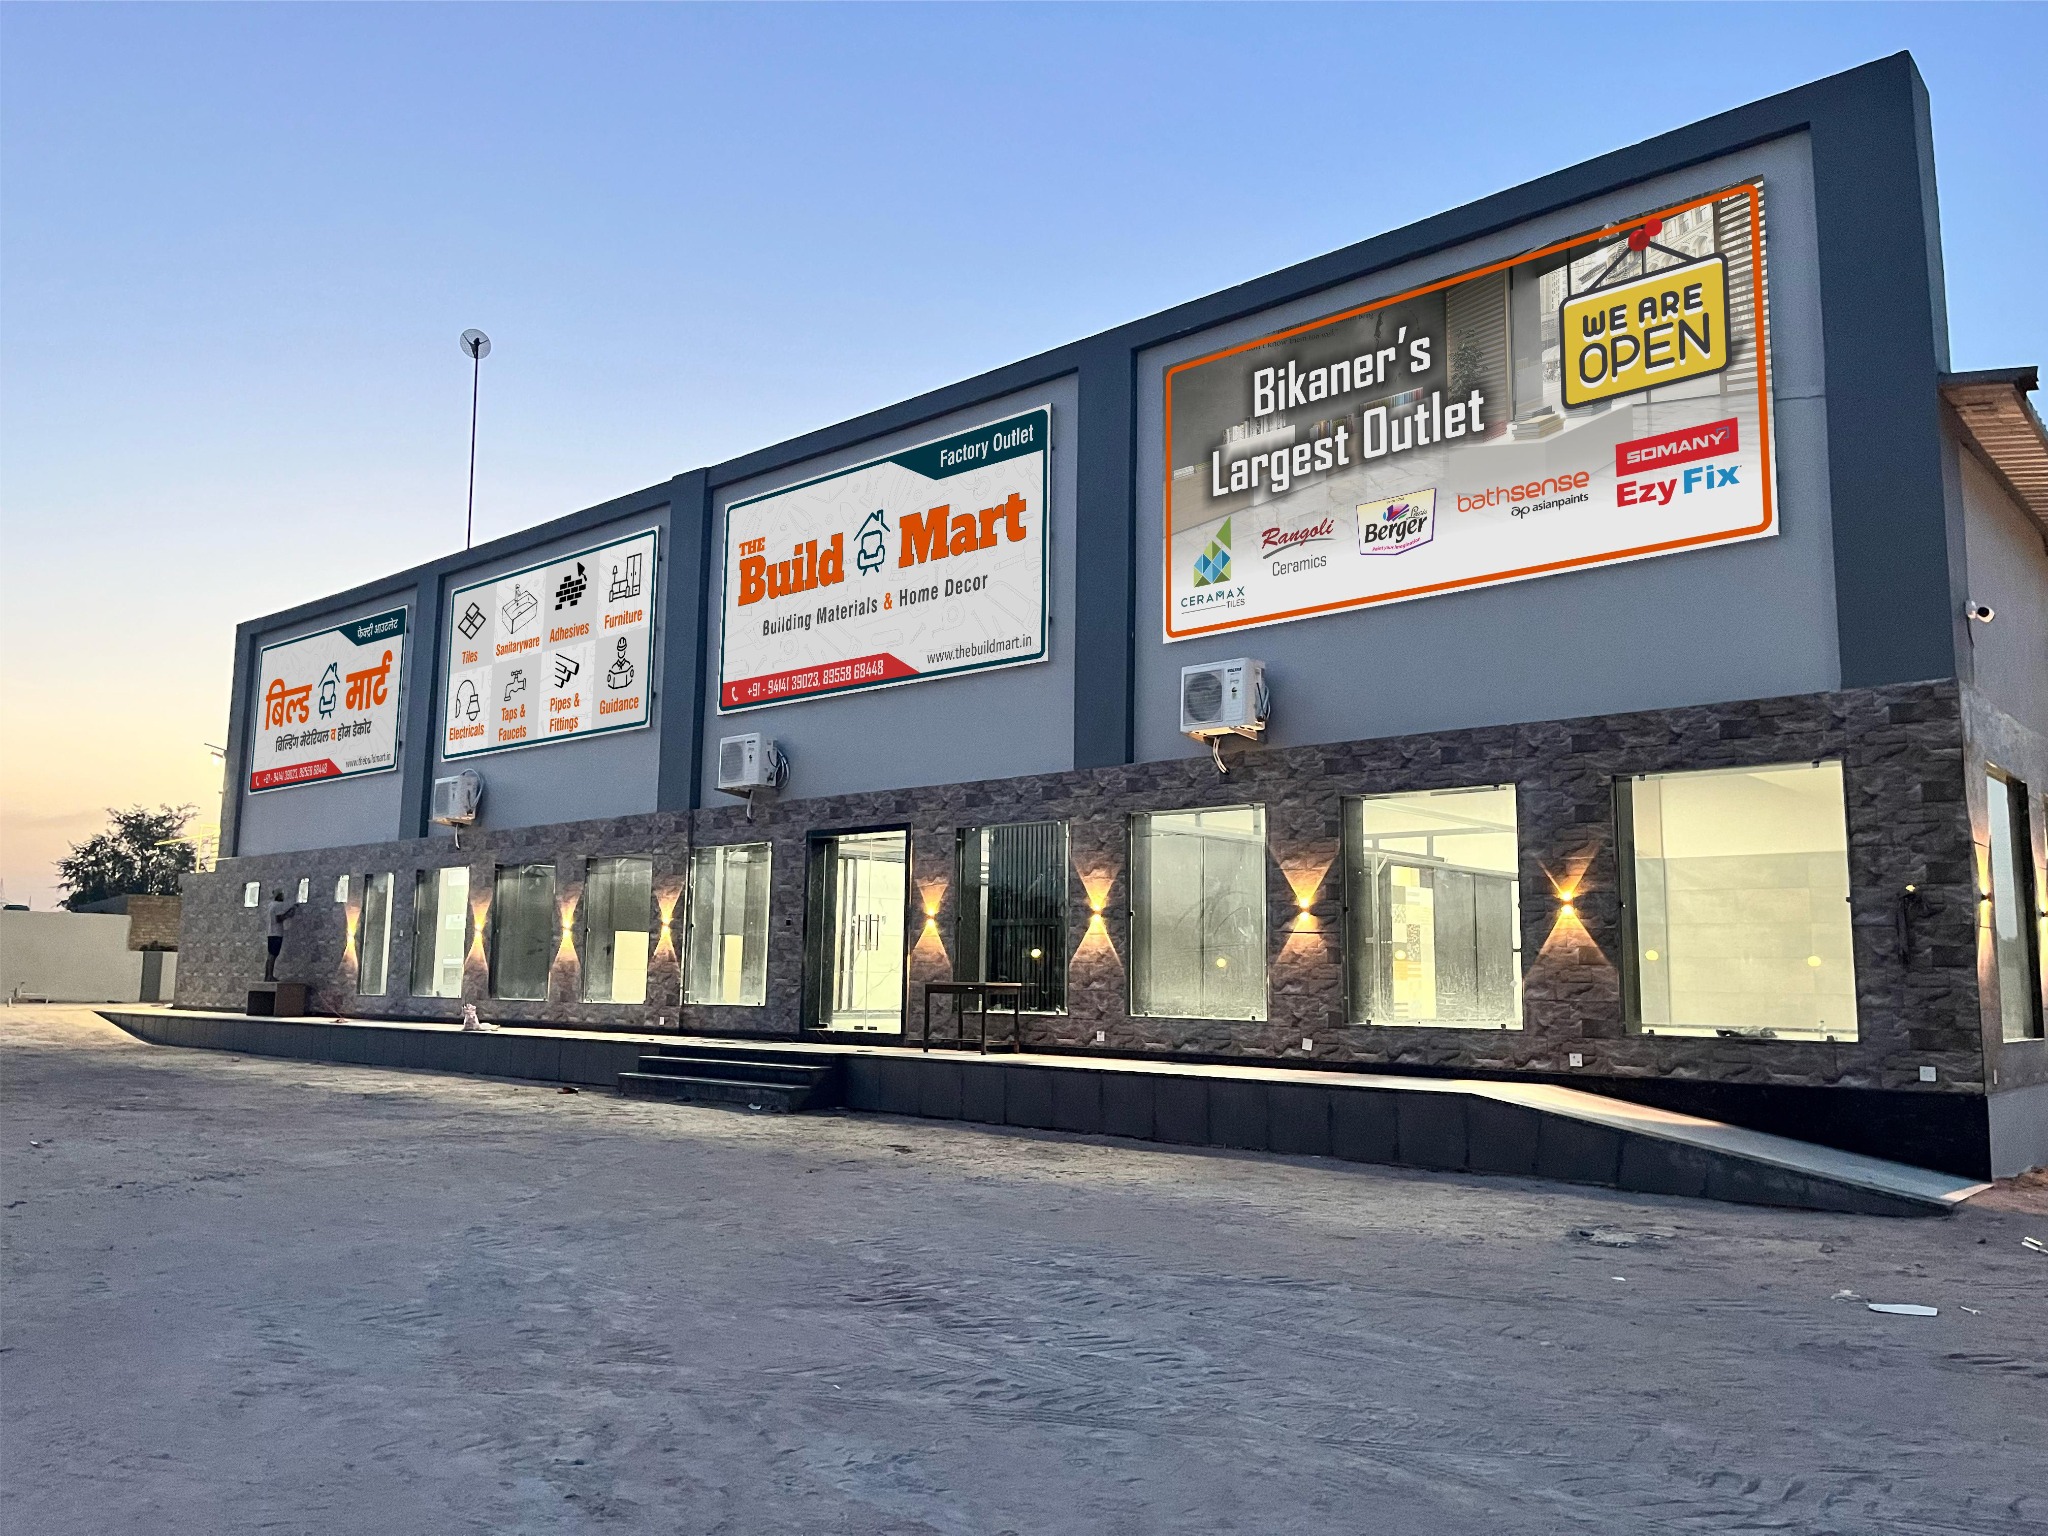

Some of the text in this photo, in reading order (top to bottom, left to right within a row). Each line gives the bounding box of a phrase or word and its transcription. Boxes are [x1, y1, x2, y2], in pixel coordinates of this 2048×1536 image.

[1583, 283, 1703, 342] WE ARE
[1579, 312, 1710, 388] OPEN
[940, 424, 1034, 468] Factory Outlet
[1212, 389, 1484, 497] Largest Outlet
[1626, 430, 1726, 465] SOMANY
[1456, 470, 1590, 512] bathsense
[1616, 464, 1740, 508] Ezy Fix
[1532, 493, 1588, 512] asianpaints
[1262, 518, 1334, 549] Rangoli
[1364, 516, 1428, 544] Berger
[738, 536, 765, 556] THE
[738, 492, 1027, 606] Build Mart
[1272, 554, 1326, 576] Ceramics
[762, 575, 988, 636] Building Materials & Home Decor
[1180, 586, 1244, 608] CERAMAX
[1226, 598, 1245, 609] TILES
[604, 608, 643, 629] Furniture
[549, 622, 589, 643] Adhesives
[462, 650, 478, 664] Tiles
[496, 636, 540, 656] Sanitaryware
[927, 634, 1032, 664] www.thebuildmart.in
[748, 682, 760, 697] +91
[823, 666, 851, 685] 89558
[854, 660, 883, 679] 68448
[265, 650, 392, 730] बिल्ड मार्ट
[501, 704, 526, 722] Taps &
[550, 692, 580, 714] Pipes &
[600, 696, 639, 715] Guidance
[330, 728, 336, 741] व
[338, 723, 351, 741] होम
[449, 722, 485, 741] Electricals
[498, 727, 527, 742] Faucets
[549, 715, 578, 733] Fittings
